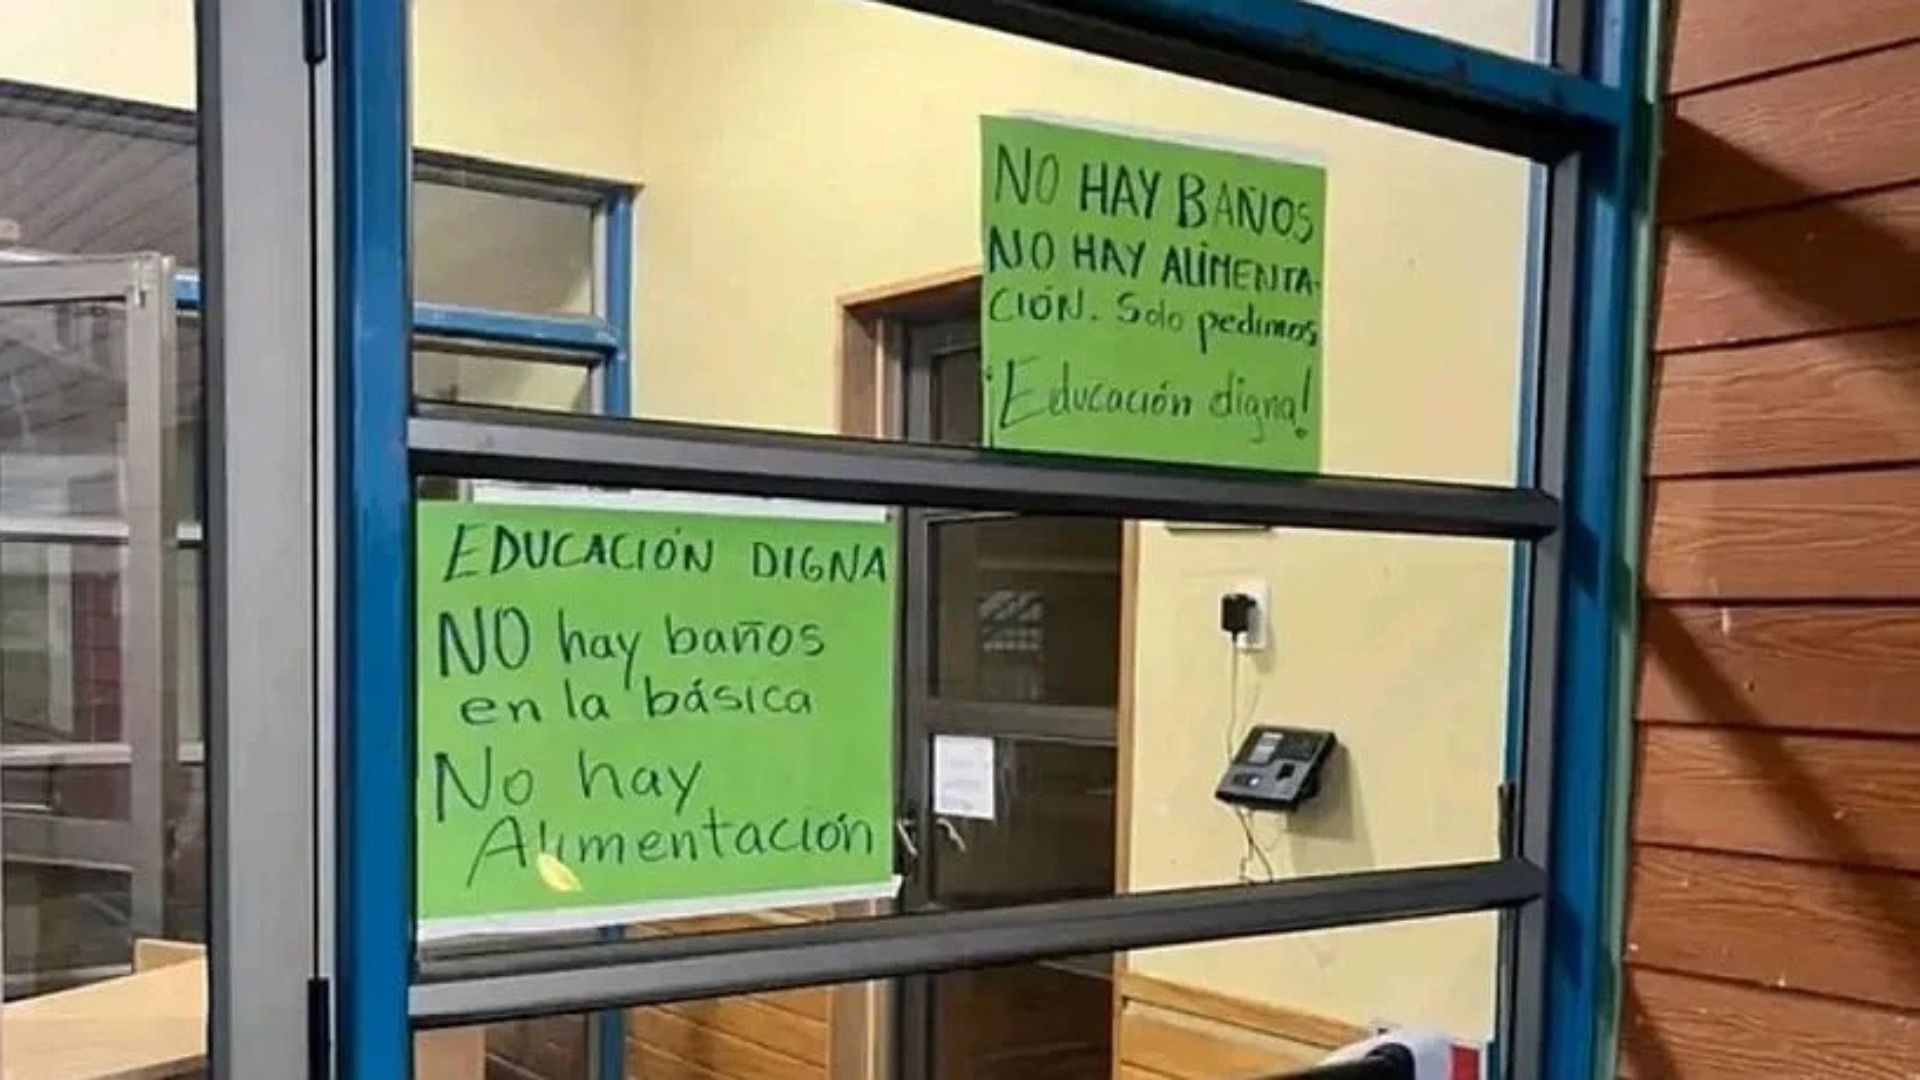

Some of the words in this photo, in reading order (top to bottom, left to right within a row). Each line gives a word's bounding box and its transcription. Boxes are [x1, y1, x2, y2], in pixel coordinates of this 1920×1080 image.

[994, 143, 1060, 205] NO
[1079, 162, 1162, 221] HAY
[1178, 172, 1315, 245] BAÑOS
[988, 224, 1055, 273] NO
[1073, 232, 1147, 279] HAY
[1115, 292, 1184, 333] Solo
[1197, 303, 1318, 354] pedimos
[1208, 365, 1313, 445] digna!
[443, 522, 715, 582] EDUCACIÓN
[751, 541, 888, 583] DIGNA
[438, 605, 531, 677] NO
[558, 608, 641, 690] hay
[665, 613, 826, 658] baños
[459, 695, 543, 726] en
[564, 679, 610, 722] la
[644, 675, 812, 719] básica
[434, 746, 534, 823] No
[578, 749, 703, 815] hay
[467, 806, 874, 886] Alimentación
